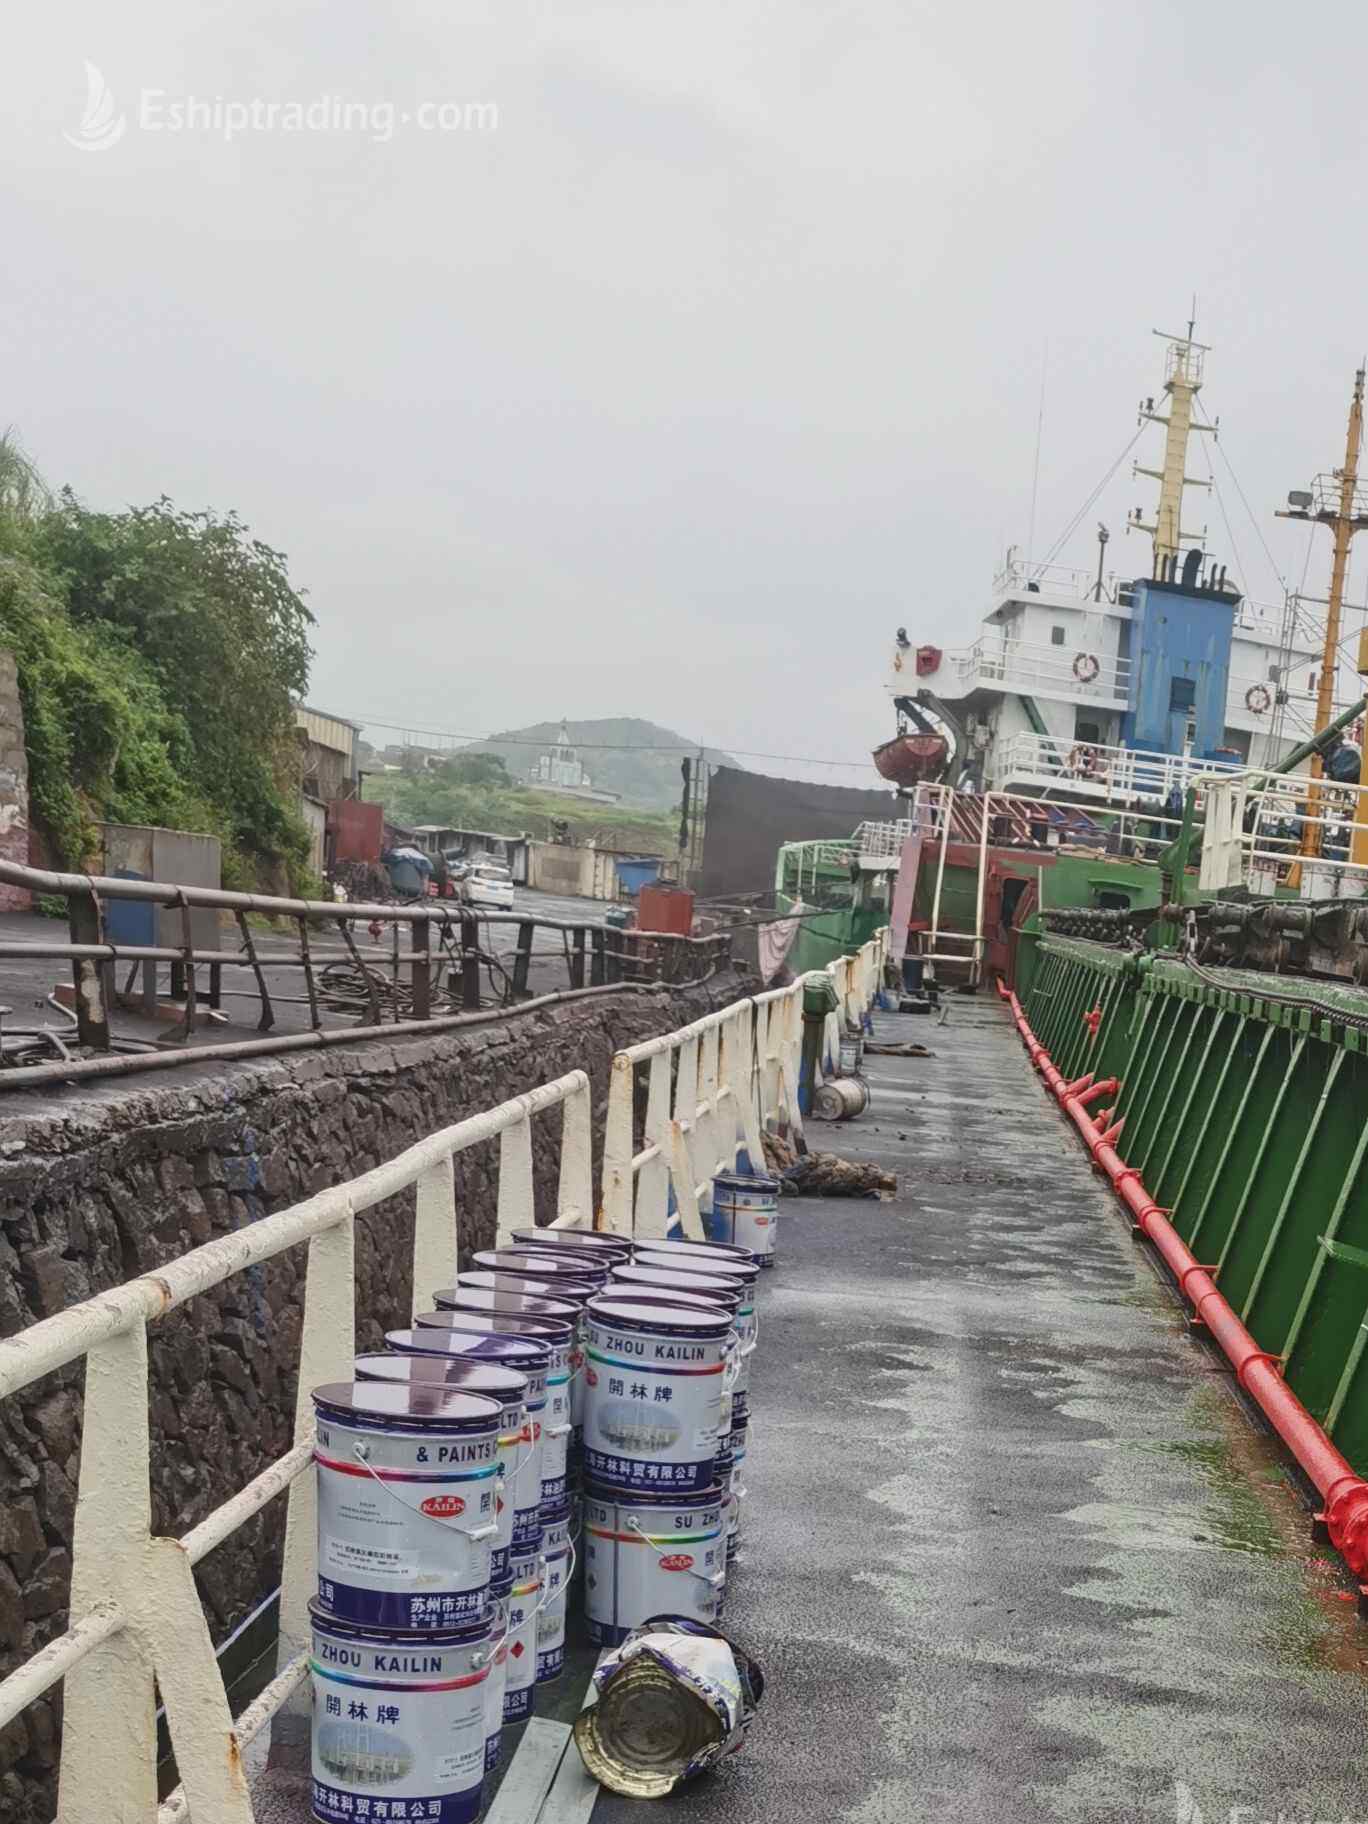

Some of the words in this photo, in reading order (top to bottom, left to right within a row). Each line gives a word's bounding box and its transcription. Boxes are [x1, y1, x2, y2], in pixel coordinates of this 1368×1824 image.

[606, 1336, 645, 1355] ZHOU
[655, 1345, 705, 1361] KAILIN
[416, 1446, 429, 1463] &
[438, 1443, 491, 1463] PAINTS
[674, 1515, 693, 1529] SU
[321, 1643, 361, 1668] ZHOU
[374, 1655, 442, 1673] KAILIN
